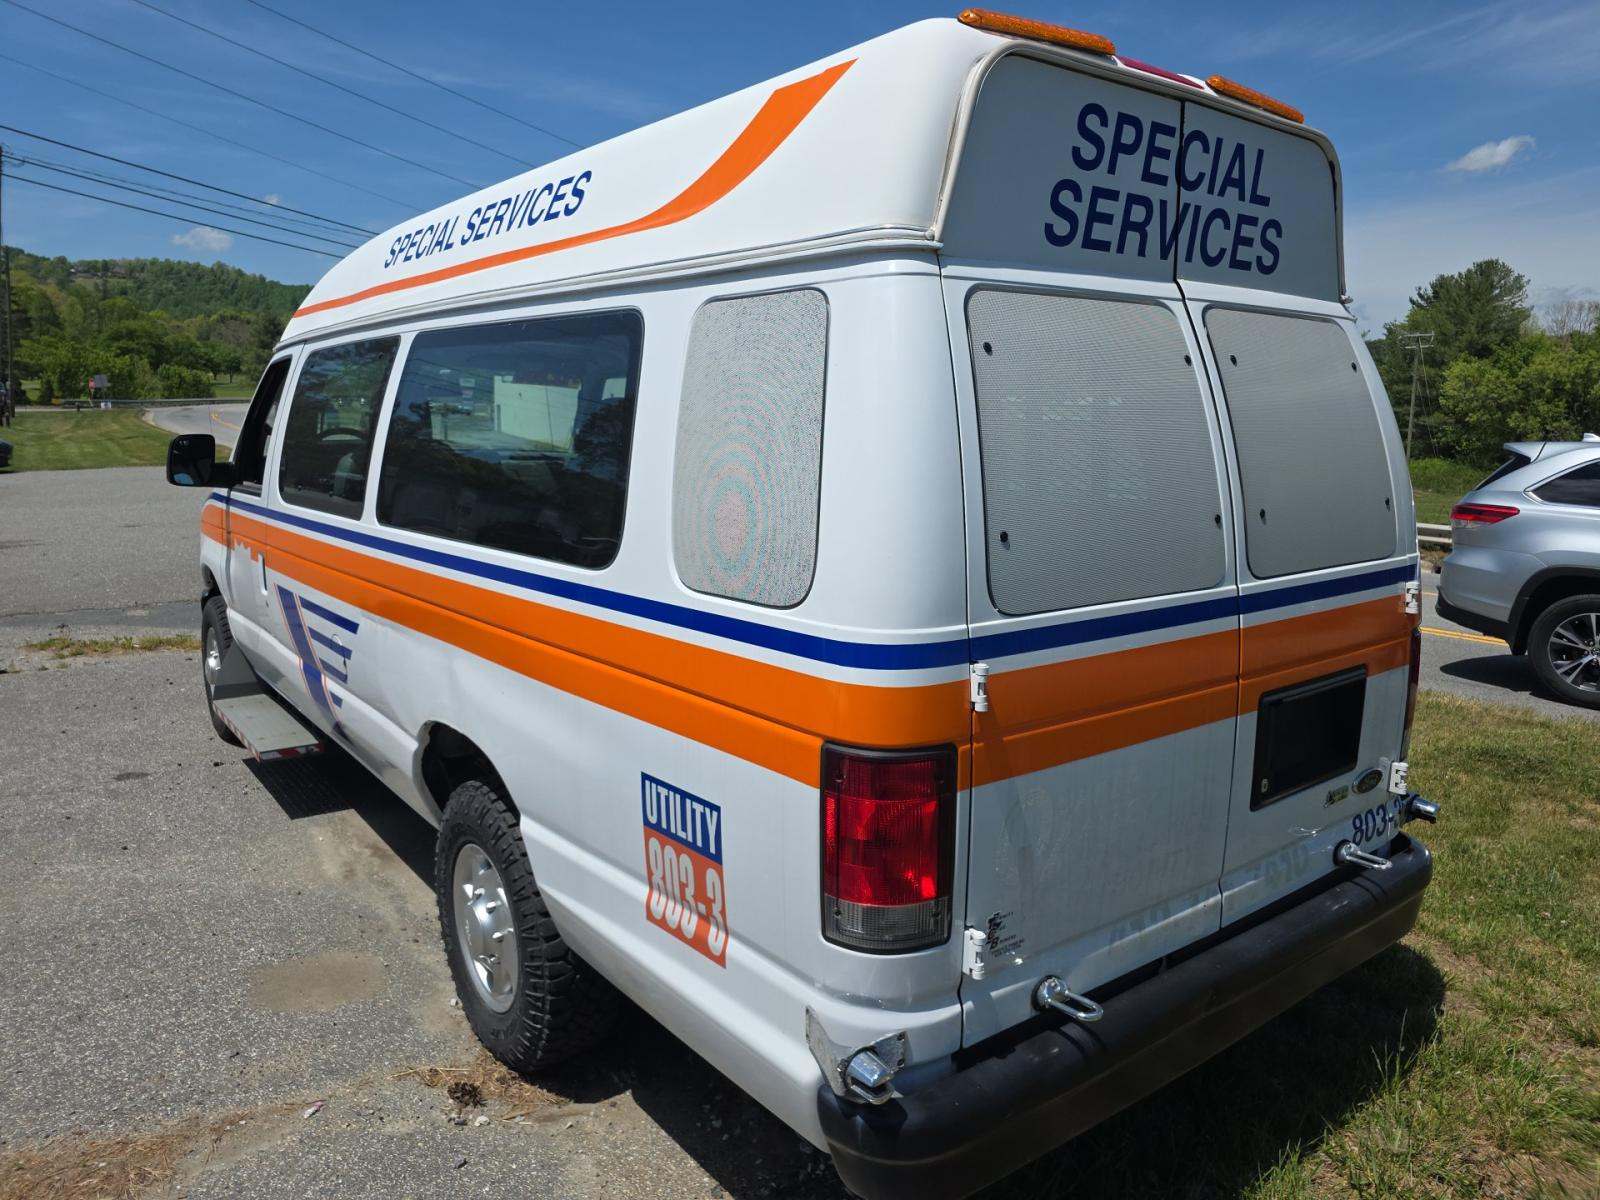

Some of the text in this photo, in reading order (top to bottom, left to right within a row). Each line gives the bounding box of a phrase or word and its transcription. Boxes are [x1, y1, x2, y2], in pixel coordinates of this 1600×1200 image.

[1071, 102, 1271, 207] SPECIAL
[384, 170, 592, 269] SPECIAL SERVICES
[1044, 178, 1283, 275] SERVICES
[644, 779, 718, 855] UTILITY
[648, 836, 726, 957] 803-3
